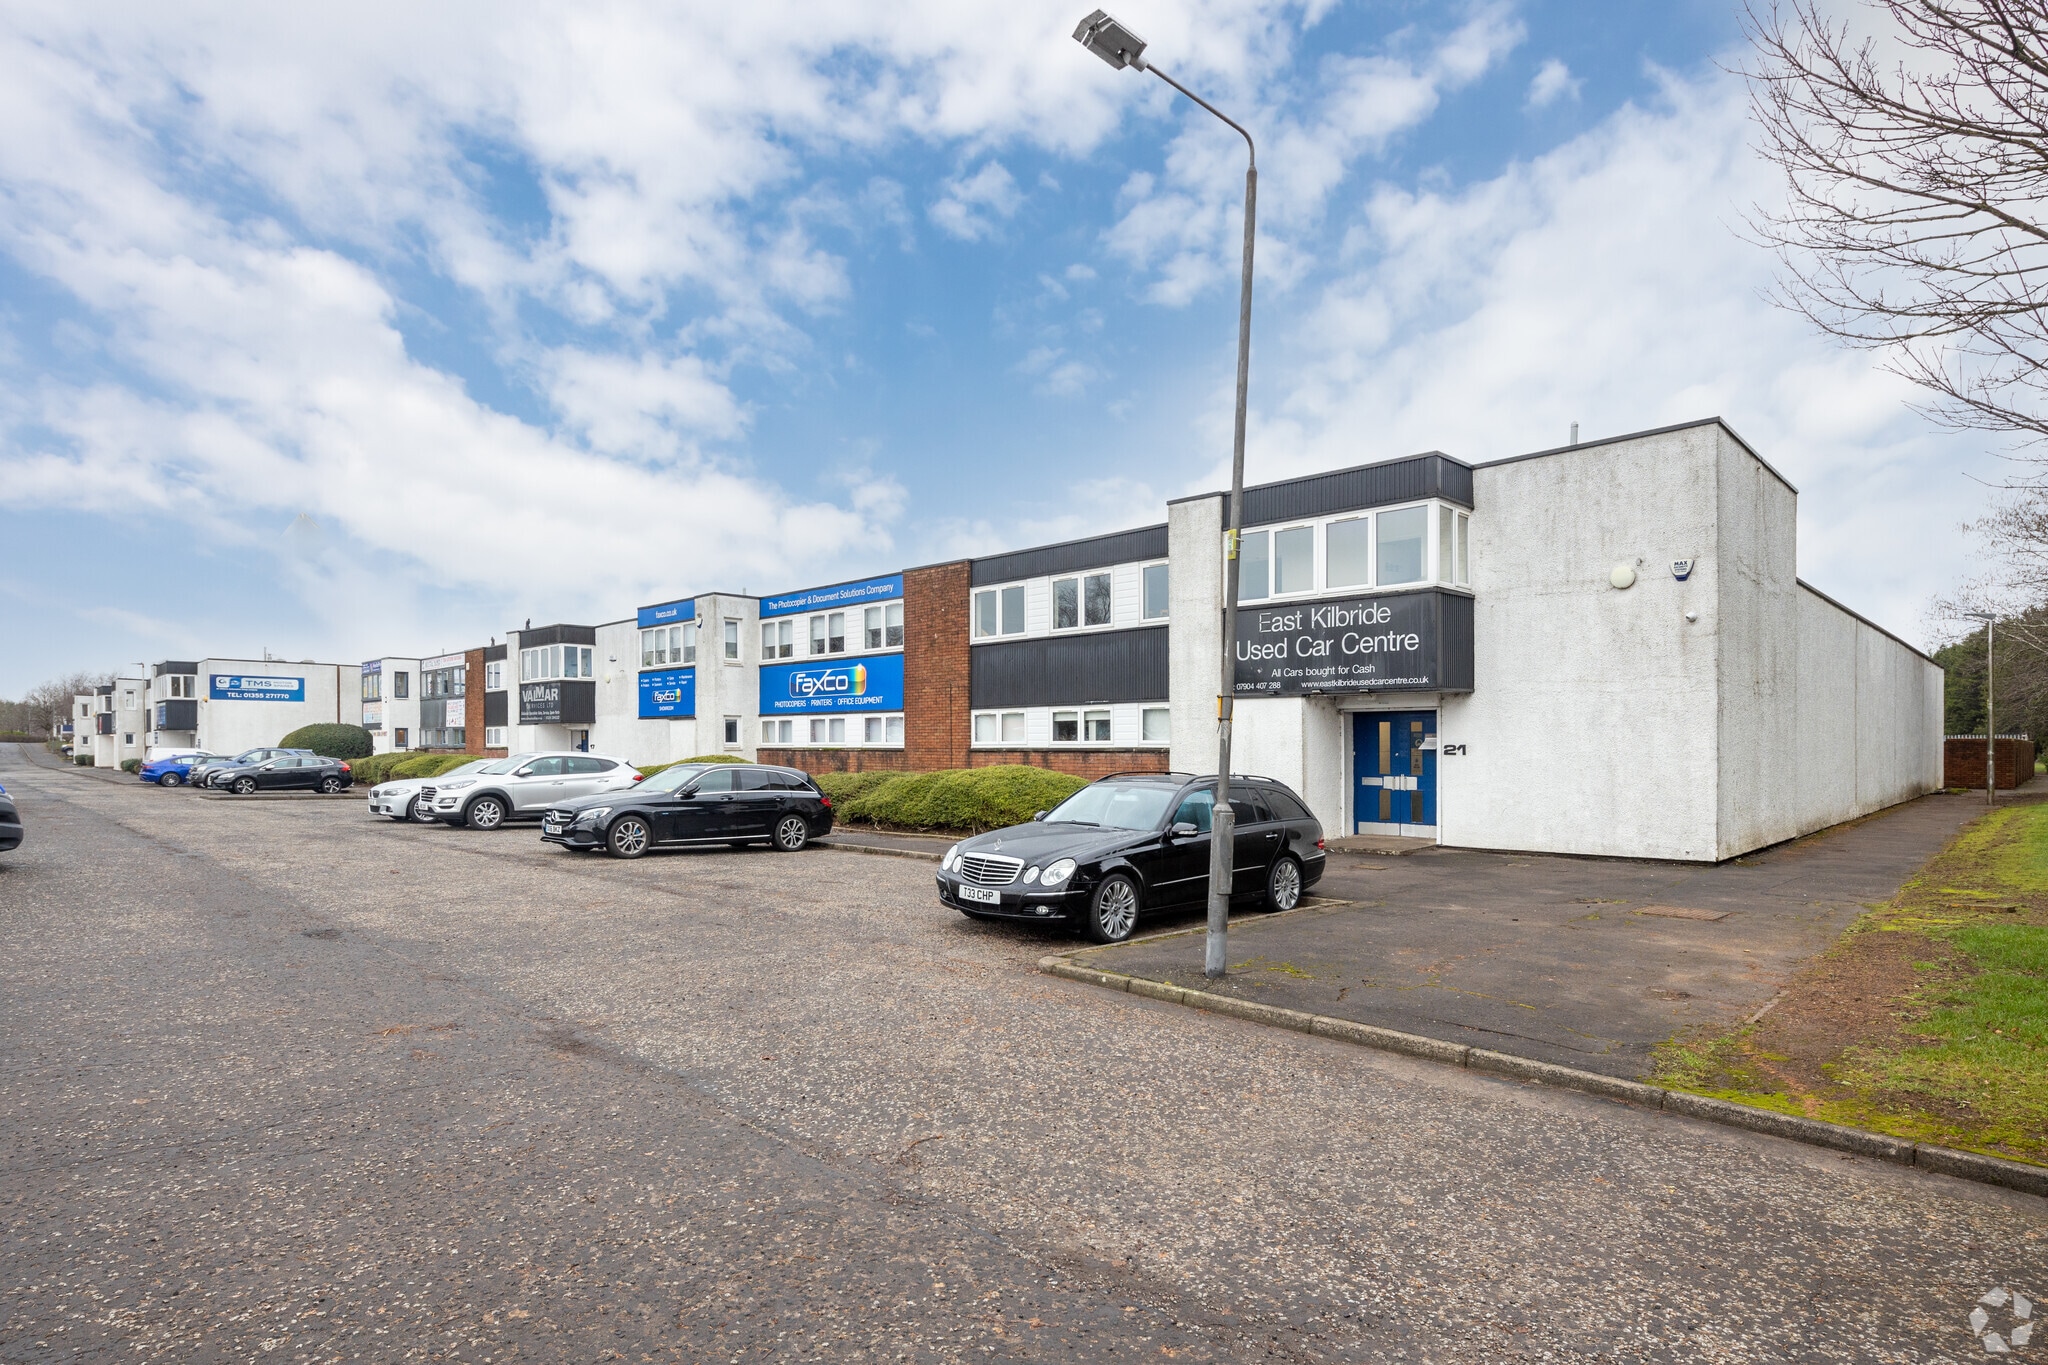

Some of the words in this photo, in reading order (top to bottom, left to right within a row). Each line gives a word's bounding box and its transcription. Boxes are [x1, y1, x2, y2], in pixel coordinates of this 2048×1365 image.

[768, 602, 777, 610] The
[778, 598, 807, 609] Photocopier
[807, 596, 812, 604] &
[813, 592, 839, 603] Document
[840, 588, 865, 599] Solutions
[866, 584, 894, 596] Company
[1259, 610, 1303, 633] East
[1311, 602, 1391, 629] Kilbride
[1236, 638, 1288, 661] Used
[1295, 636, 1334, 657] Car
[1341, 631, 1419, 655] Centre
[1271, 668, 1281, 678] All
[1283, 667, 1303, 677] Cars
[1305, 666, 1335, 678] bought
[1337, 665, 1350, 675] for
[1352, 664, 1376, 674] Cash
[1256, 682, 1267, 690] 407
[1268, 681, 1281, 689] 288
[1301, 676, 1429, 689] www.eastkilbrideusedcarcentre.co.uk
[522, 686, 559, 702] VALMAR
[774, 700, 807, 708] PHOTOCOPIERS
[810, 698, 833, 706] PRINTERS
[837, 697, 855, 705] OFFICE
[855, 696, 883, 705] EQUIPMENT
[1443, 744, 1467, 756] 21
[964, 887, 976, 898] T33
[976, 890, 994, 901] CHP
